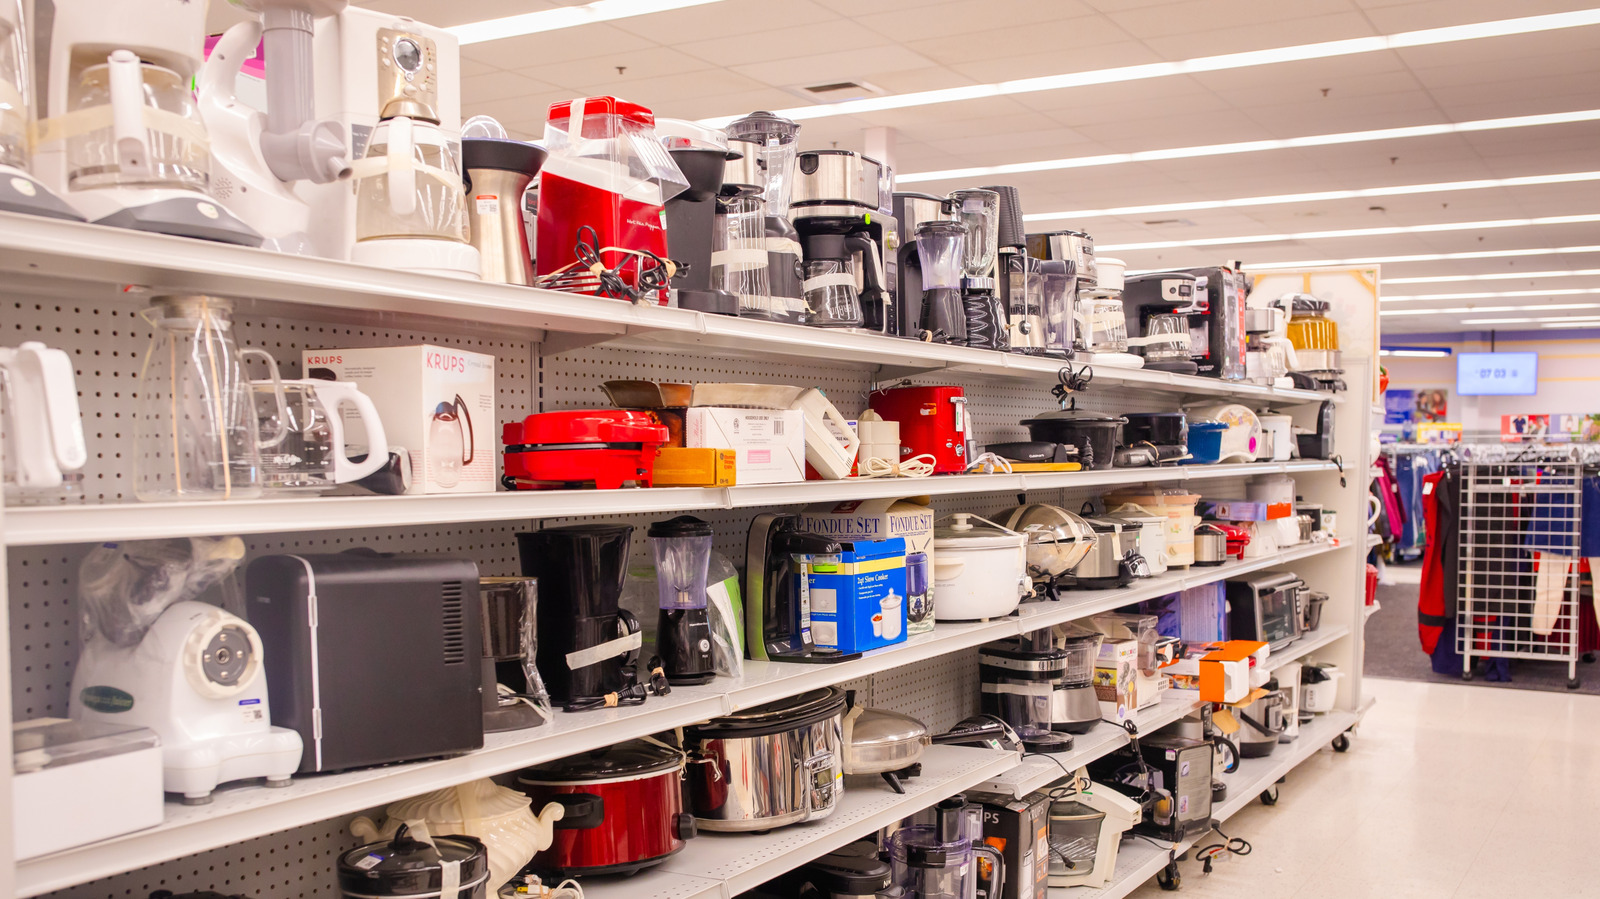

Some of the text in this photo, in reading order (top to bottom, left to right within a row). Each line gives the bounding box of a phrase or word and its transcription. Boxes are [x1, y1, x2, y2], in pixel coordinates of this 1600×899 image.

[307, 355, 343, 365] KRUPS
[427, 352, 465, 373] KRUPS
[806, 516, 880, 534] FONDUE SET
[890, 513, 932, 533] FONDUE SET
[874, 573, 889, 582] Cooker
